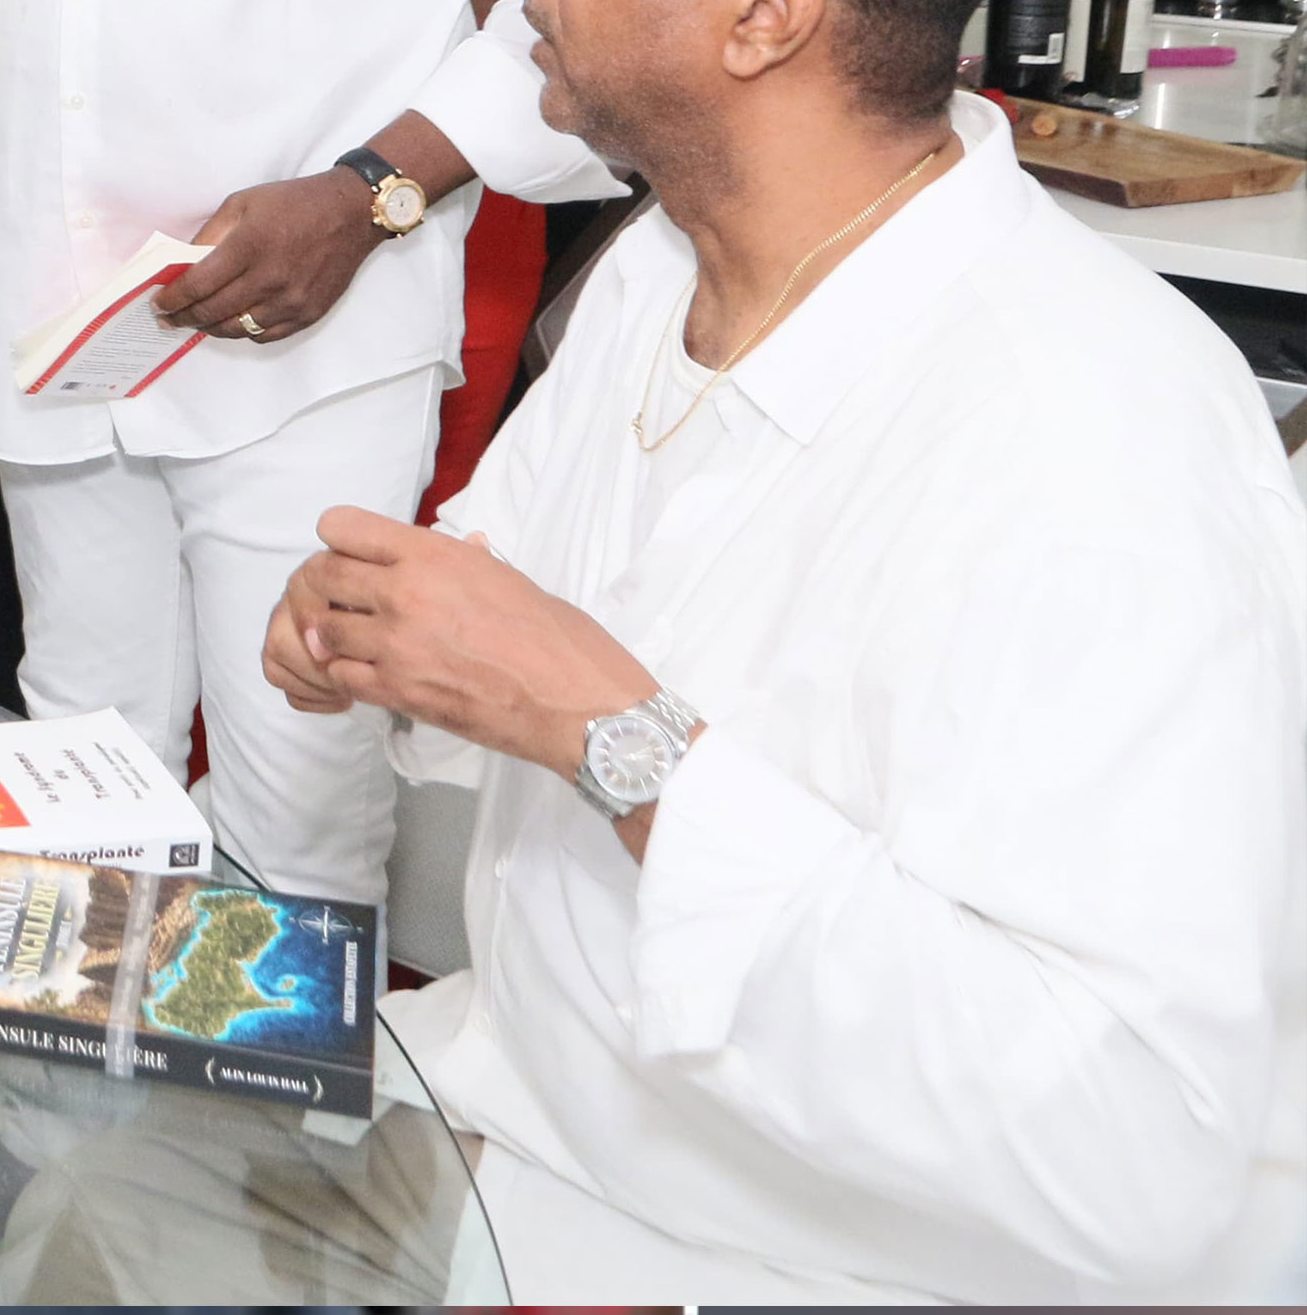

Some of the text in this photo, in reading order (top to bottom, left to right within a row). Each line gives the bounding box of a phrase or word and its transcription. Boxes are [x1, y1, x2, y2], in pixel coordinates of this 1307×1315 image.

[219, 1066, 310, 1095] ALIN LOUIS HALL
